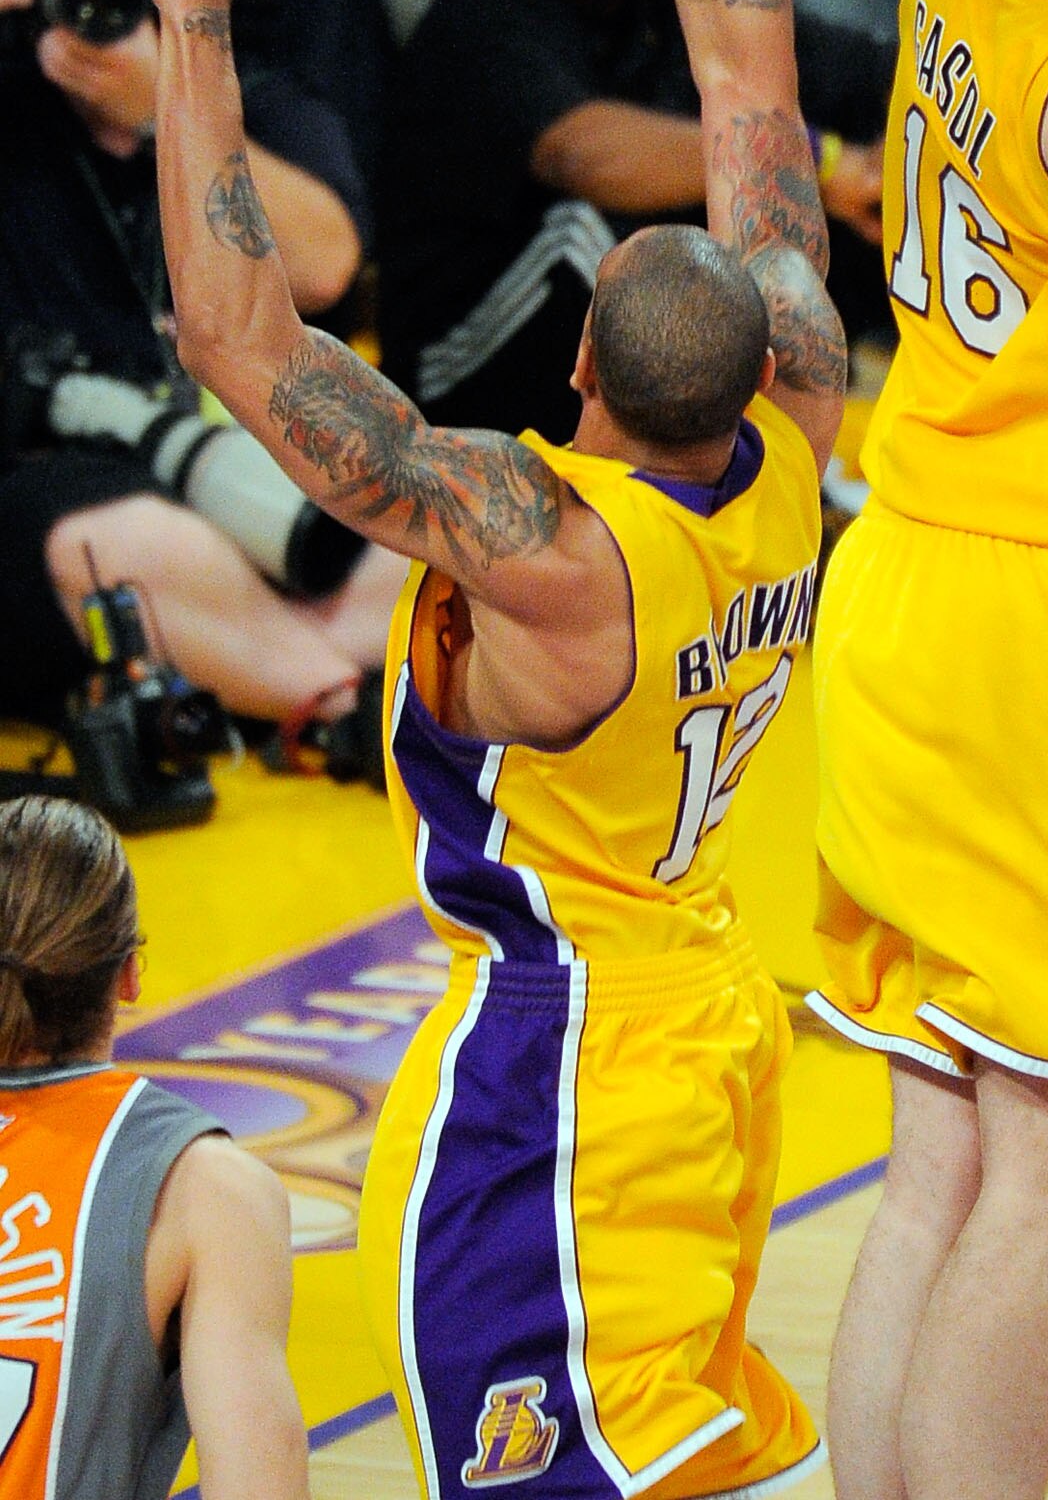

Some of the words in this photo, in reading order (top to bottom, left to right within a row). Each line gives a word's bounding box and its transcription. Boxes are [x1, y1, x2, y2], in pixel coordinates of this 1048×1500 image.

[889, 103, 1030, 359] 16
[675, 559, 817, 701] BOWN
[651, 648, 794, 885] 12
